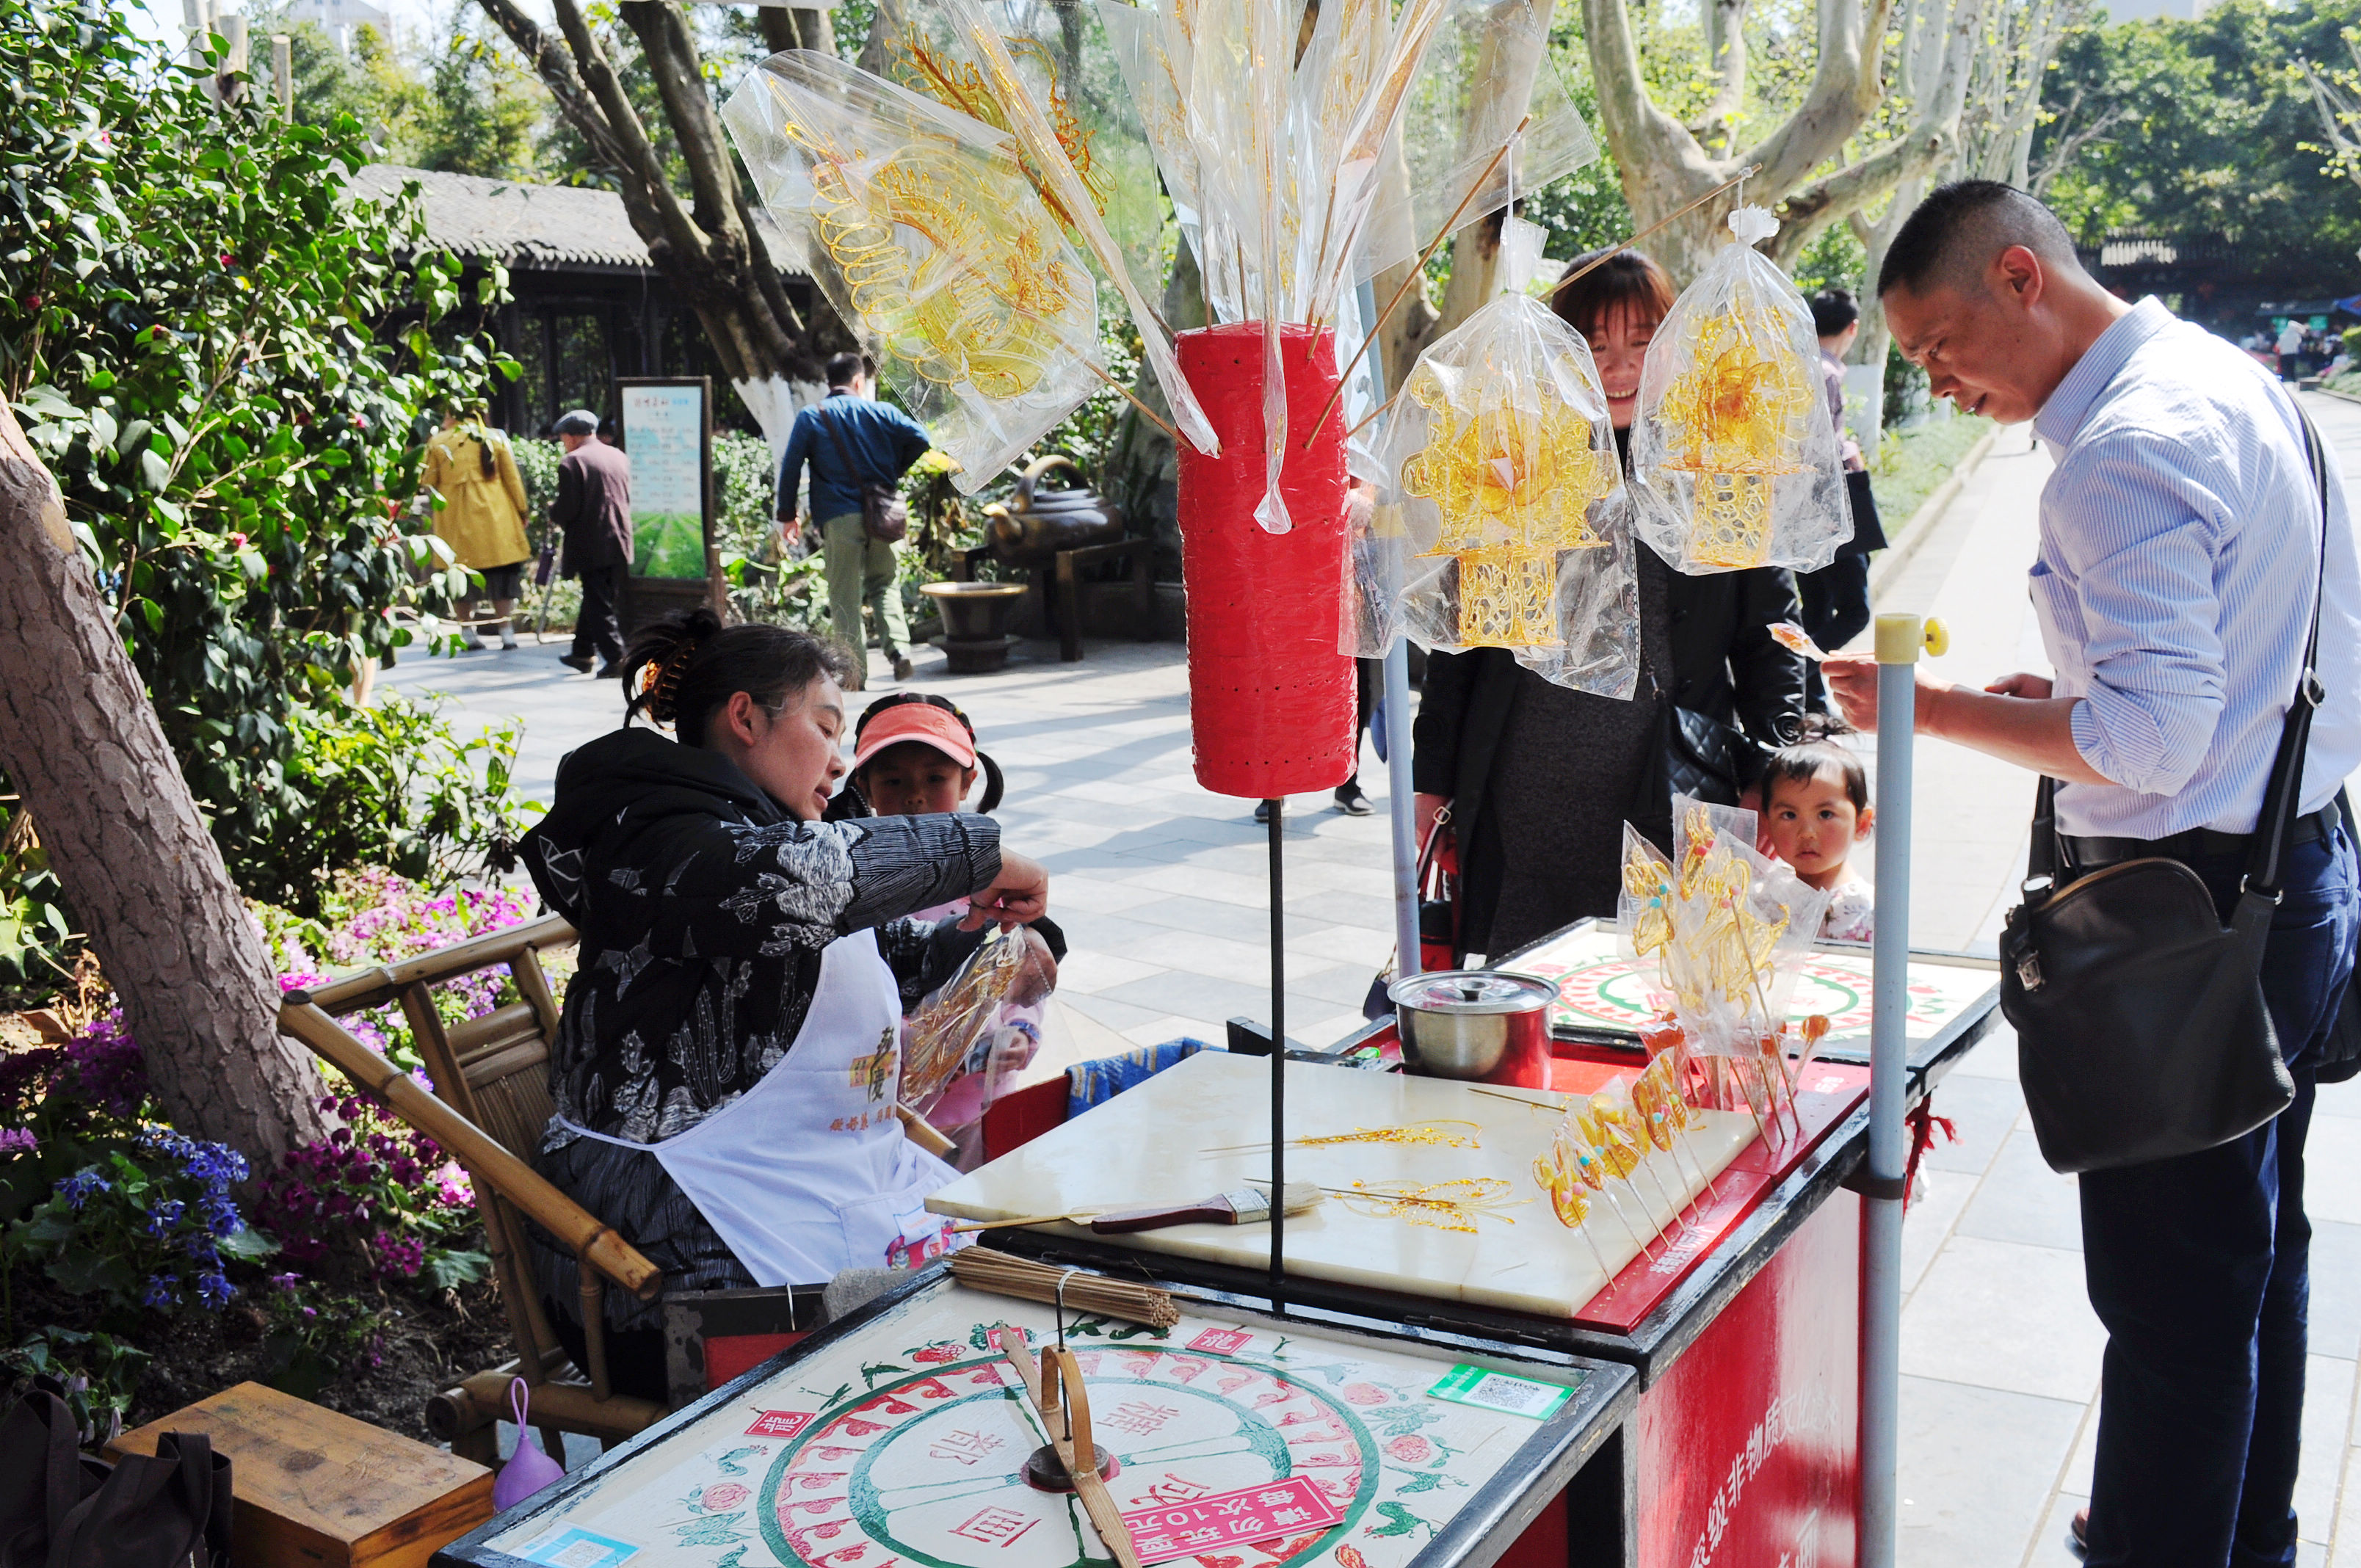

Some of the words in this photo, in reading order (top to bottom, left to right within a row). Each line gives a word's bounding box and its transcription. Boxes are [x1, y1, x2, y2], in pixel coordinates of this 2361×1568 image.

[758, 1415, 804, 1433] 龍
[929, 1429, 1006, 1466] 都
[1125, 1489, 1295, 1534] 每次10元
[1134, 1506, 1312, 1556] 请勿玩耍
